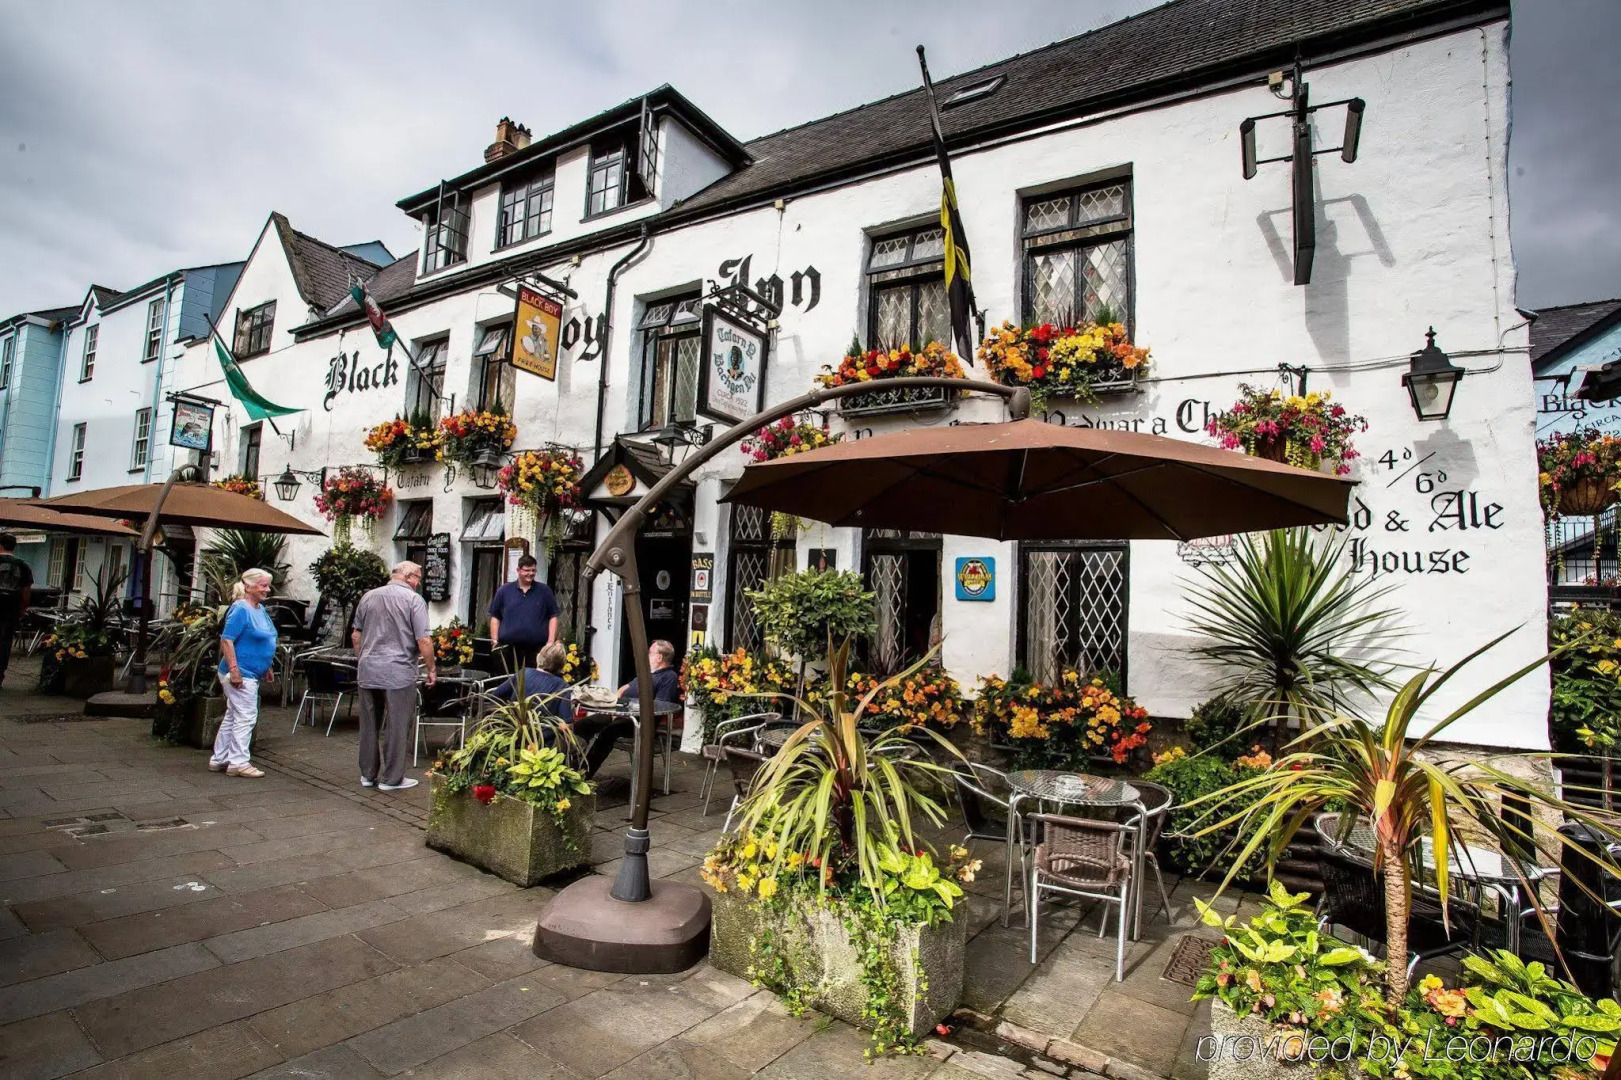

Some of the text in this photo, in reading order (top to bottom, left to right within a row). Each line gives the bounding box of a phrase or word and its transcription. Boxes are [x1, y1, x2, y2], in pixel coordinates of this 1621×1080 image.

[521, 291, 559, 316] BLACK BOY
[718, 254, 822, 316] Inn
[561, 312, 605, 363] oy
[323, 348, 399, 412] Black
[517, 357, 551, 375] FREE HOUSE
[1384, 509, 1410, 532] &
[1428, 489, 1505, 533] Ale
[692, 558, 713, 570] BASS
